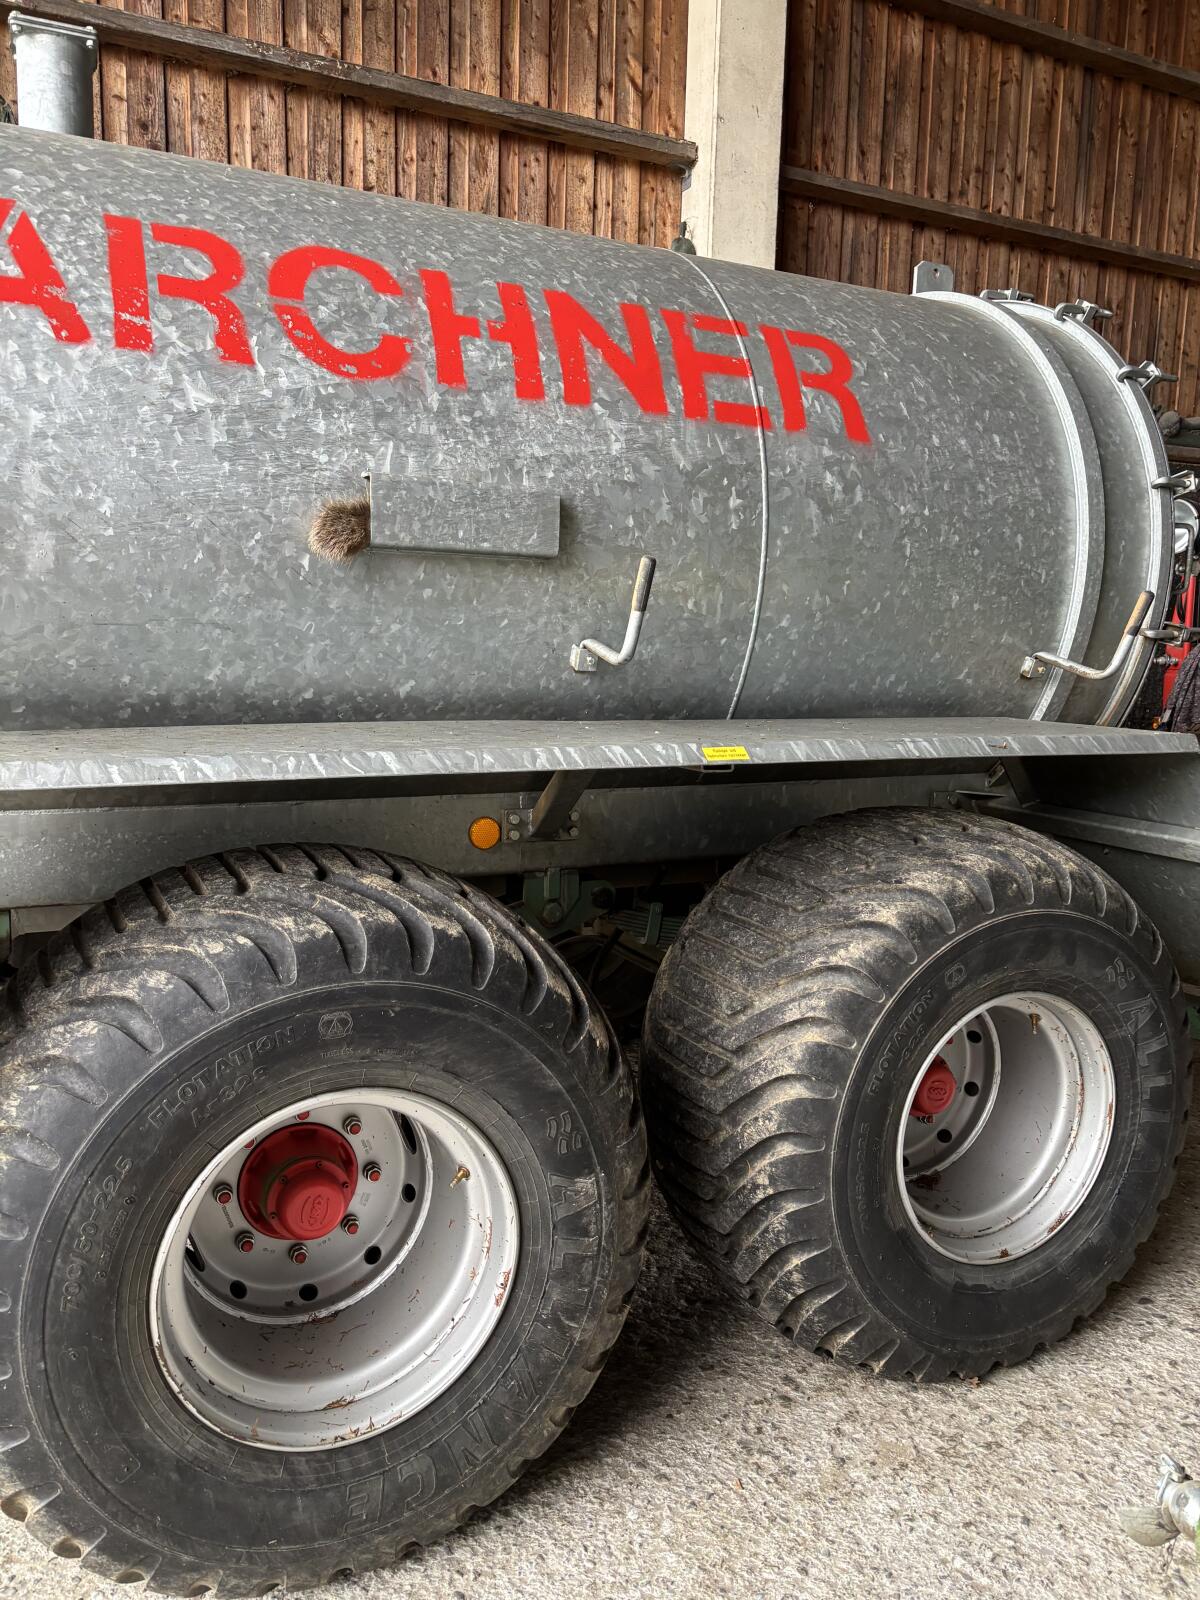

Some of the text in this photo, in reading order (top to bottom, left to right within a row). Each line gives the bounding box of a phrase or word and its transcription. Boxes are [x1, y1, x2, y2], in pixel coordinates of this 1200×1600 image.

[147, 1025, 296, 1129] FLOTATION
[868, 990, 934, 1096] FLOTATION
[60, 1154, 134, 1312] 700/50-22.5
